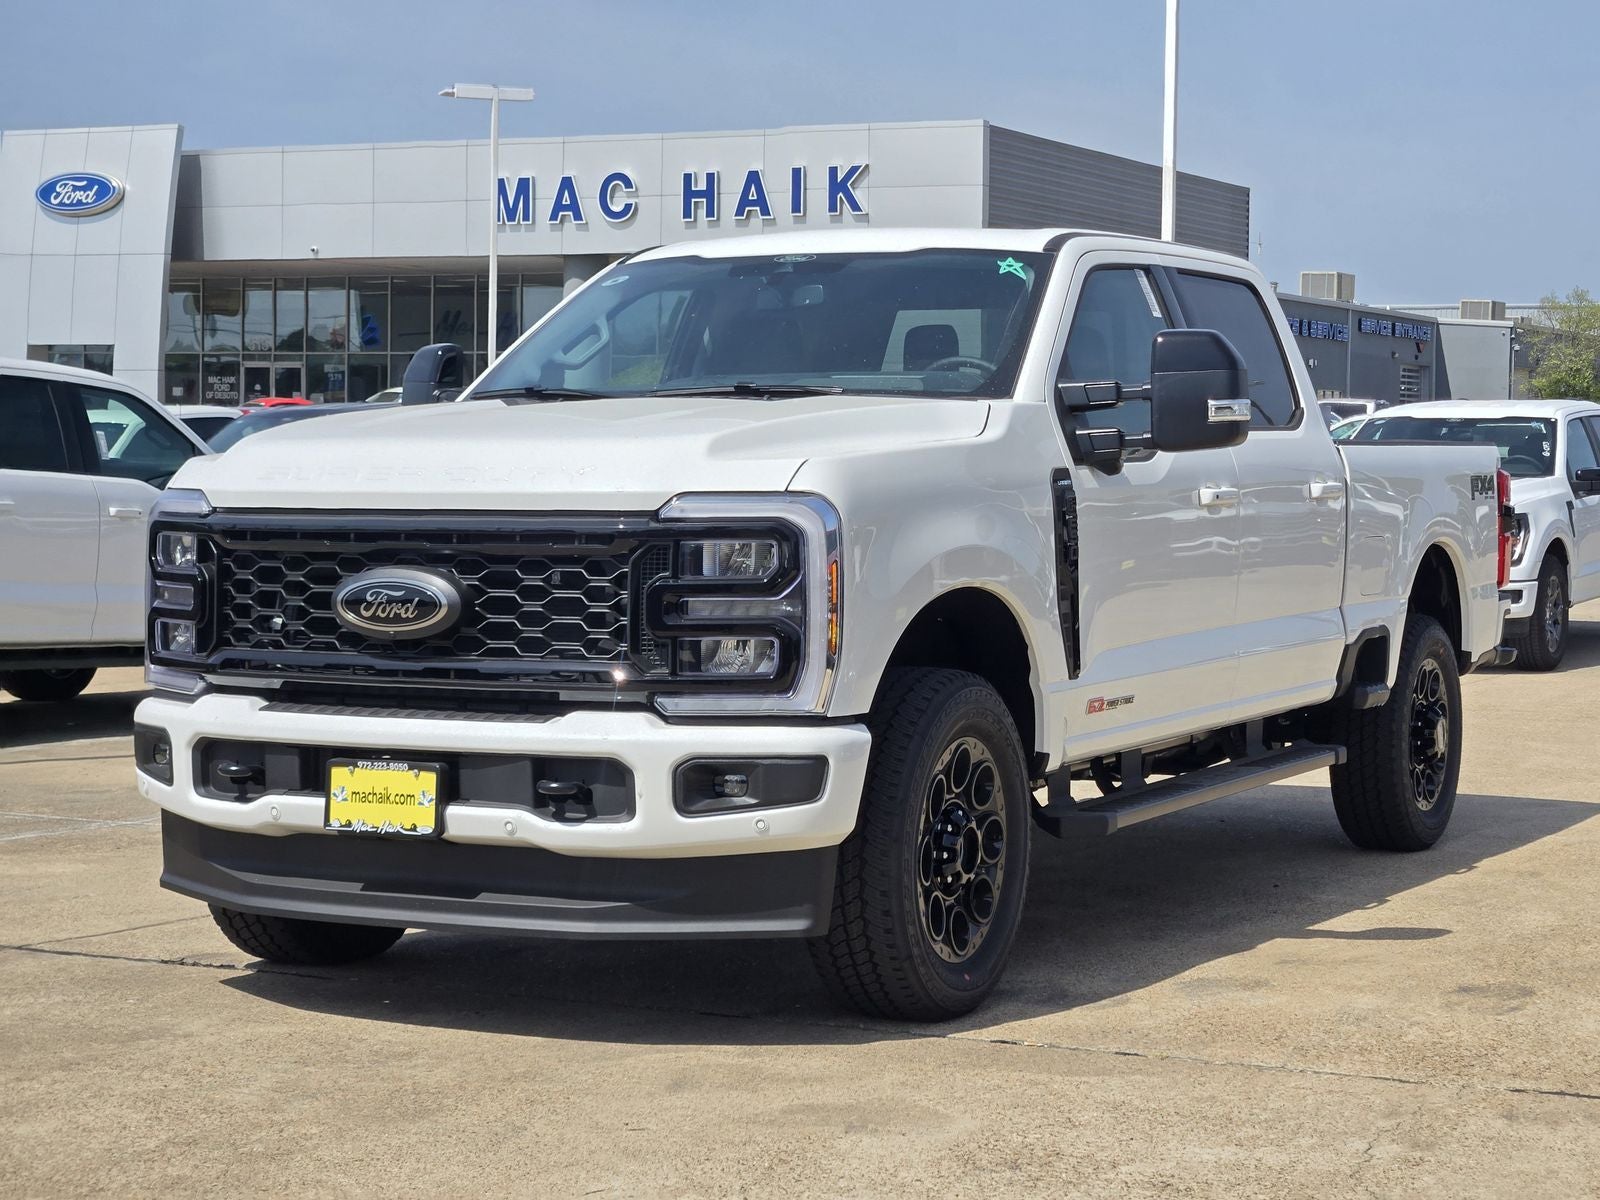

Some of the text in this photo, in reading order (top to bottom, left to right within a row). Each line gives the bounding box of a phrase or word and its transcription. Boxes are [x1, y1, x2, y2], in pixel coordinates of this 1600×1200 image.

[50, 180, 99, 205] Ford
[497, 163, 869, 225] MAC HAIK
[1310, 320, 1349, 342] SERVICE
[1361, 317, 1432, 342] SERVICE ENTRANCE
[208, 376, 237, 384] MAC HAIK
[213, 383, 231, 392] FORD
[205, 391, 214, 399] OF
[1470, 475, 1495, 501] FX4
[360, 588, 420, 619] Ford
[350, 786, 416, 806] machaik.com
[351, 819, 377, 833] Mac
[377, 819, 405, 834] Haik
